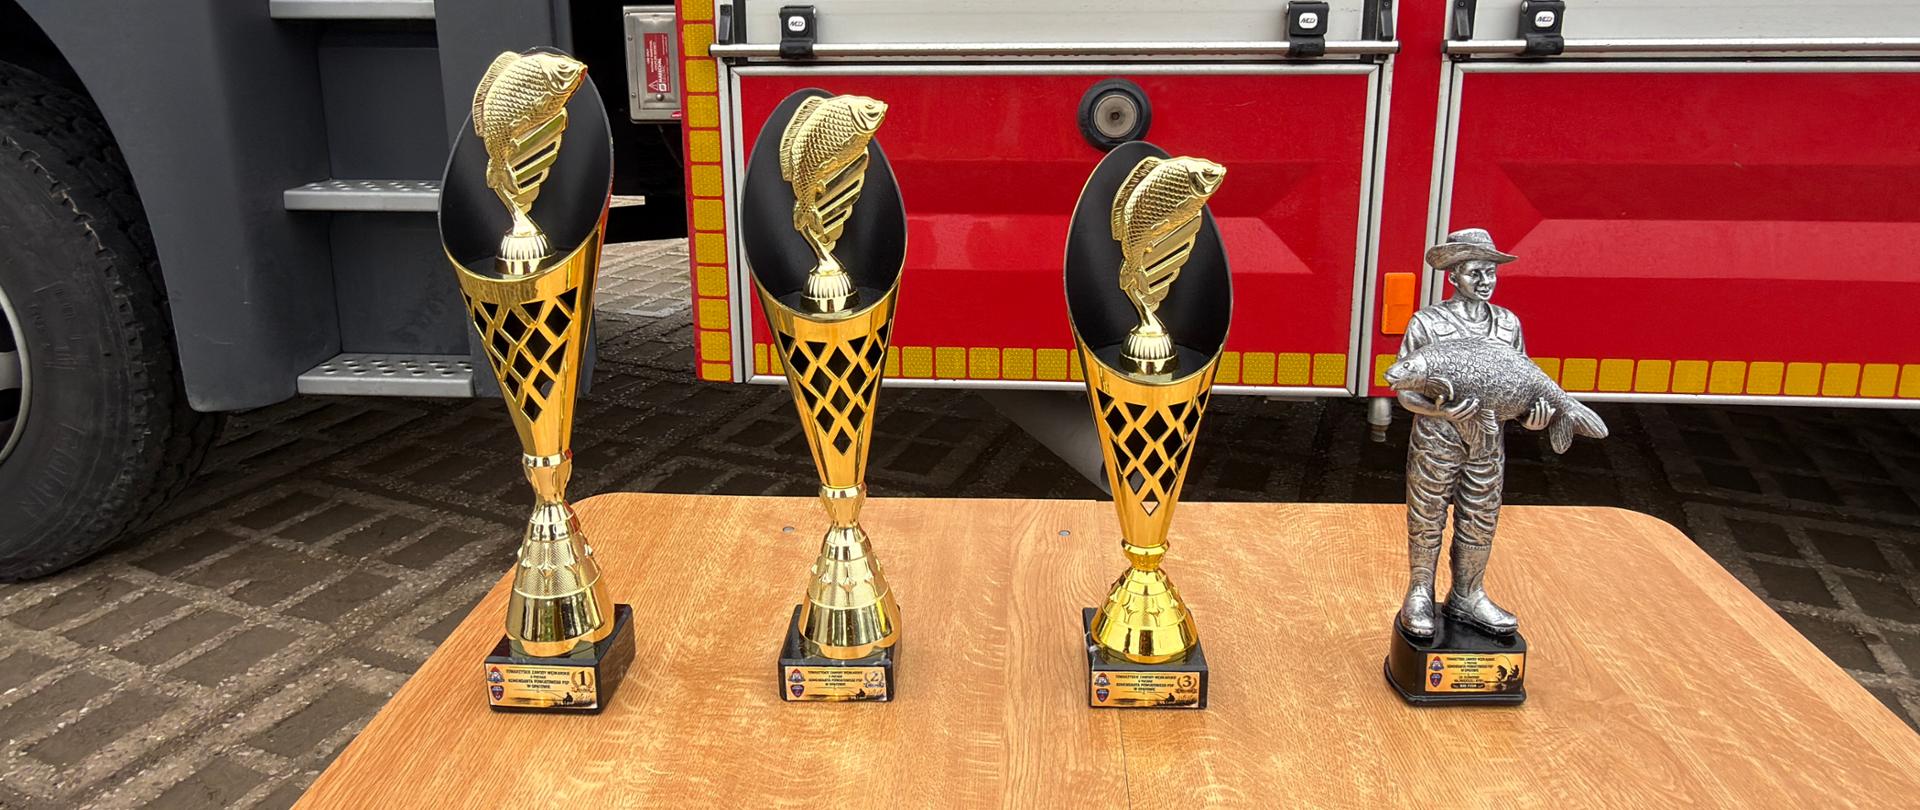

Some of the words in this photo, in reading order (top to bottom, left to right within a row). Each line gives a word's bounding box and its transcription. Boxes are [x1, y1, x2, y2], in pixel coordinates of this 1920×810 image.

[578, 670, 586, 686] 1
[870, 672, 880, 682] 2
[1182, 676, 1191, 687] 3
